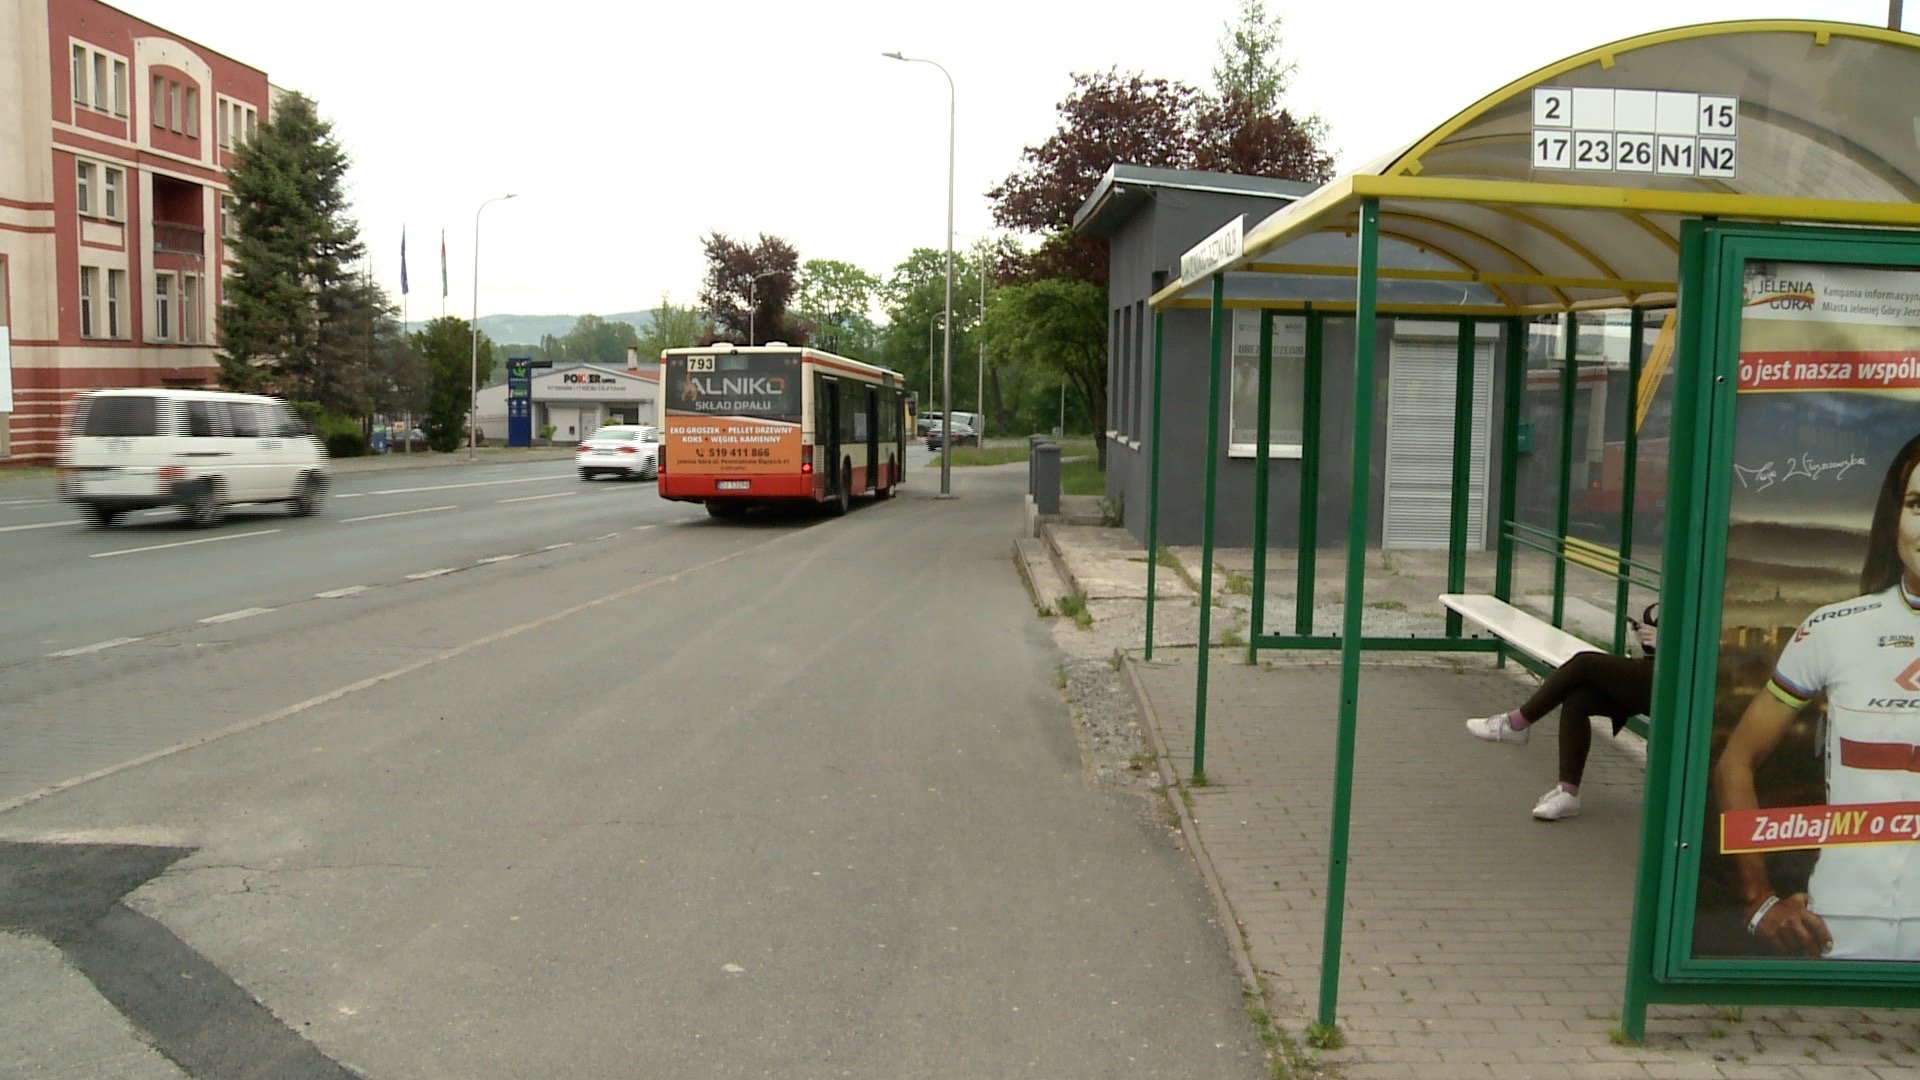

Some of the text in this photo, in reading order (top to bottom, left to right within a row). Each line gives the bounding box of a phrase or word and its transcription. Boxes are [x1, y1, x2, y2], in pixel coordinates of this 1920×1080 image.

[1544, 97, 1733, 128] 2 15
[1537, 138, 1734, 170] 17 23 26 N1 N2
[1758, 279, 1814, 294] JELENIA
[1823, 287, 1862, 299] Kampania
[1821, 301, 1848, 313] Miasta
[1880, 304, 1901, 319] Góry
[689, 359, 713, 370] 793
[1738, 359, 1753, 381] o
[1753, 359, 1792, 387] jest
[1794, 363, 1853, 380] nasza
[683, 376, 785, 397] ALNIKO
[695, 400, 771, 410] SKŁAD OPAŁU
[708, 448, 770, 457] 519 411 866
[1808, 602, 1882, 627] KROSS
[1870, 816, 1885, 835] o
